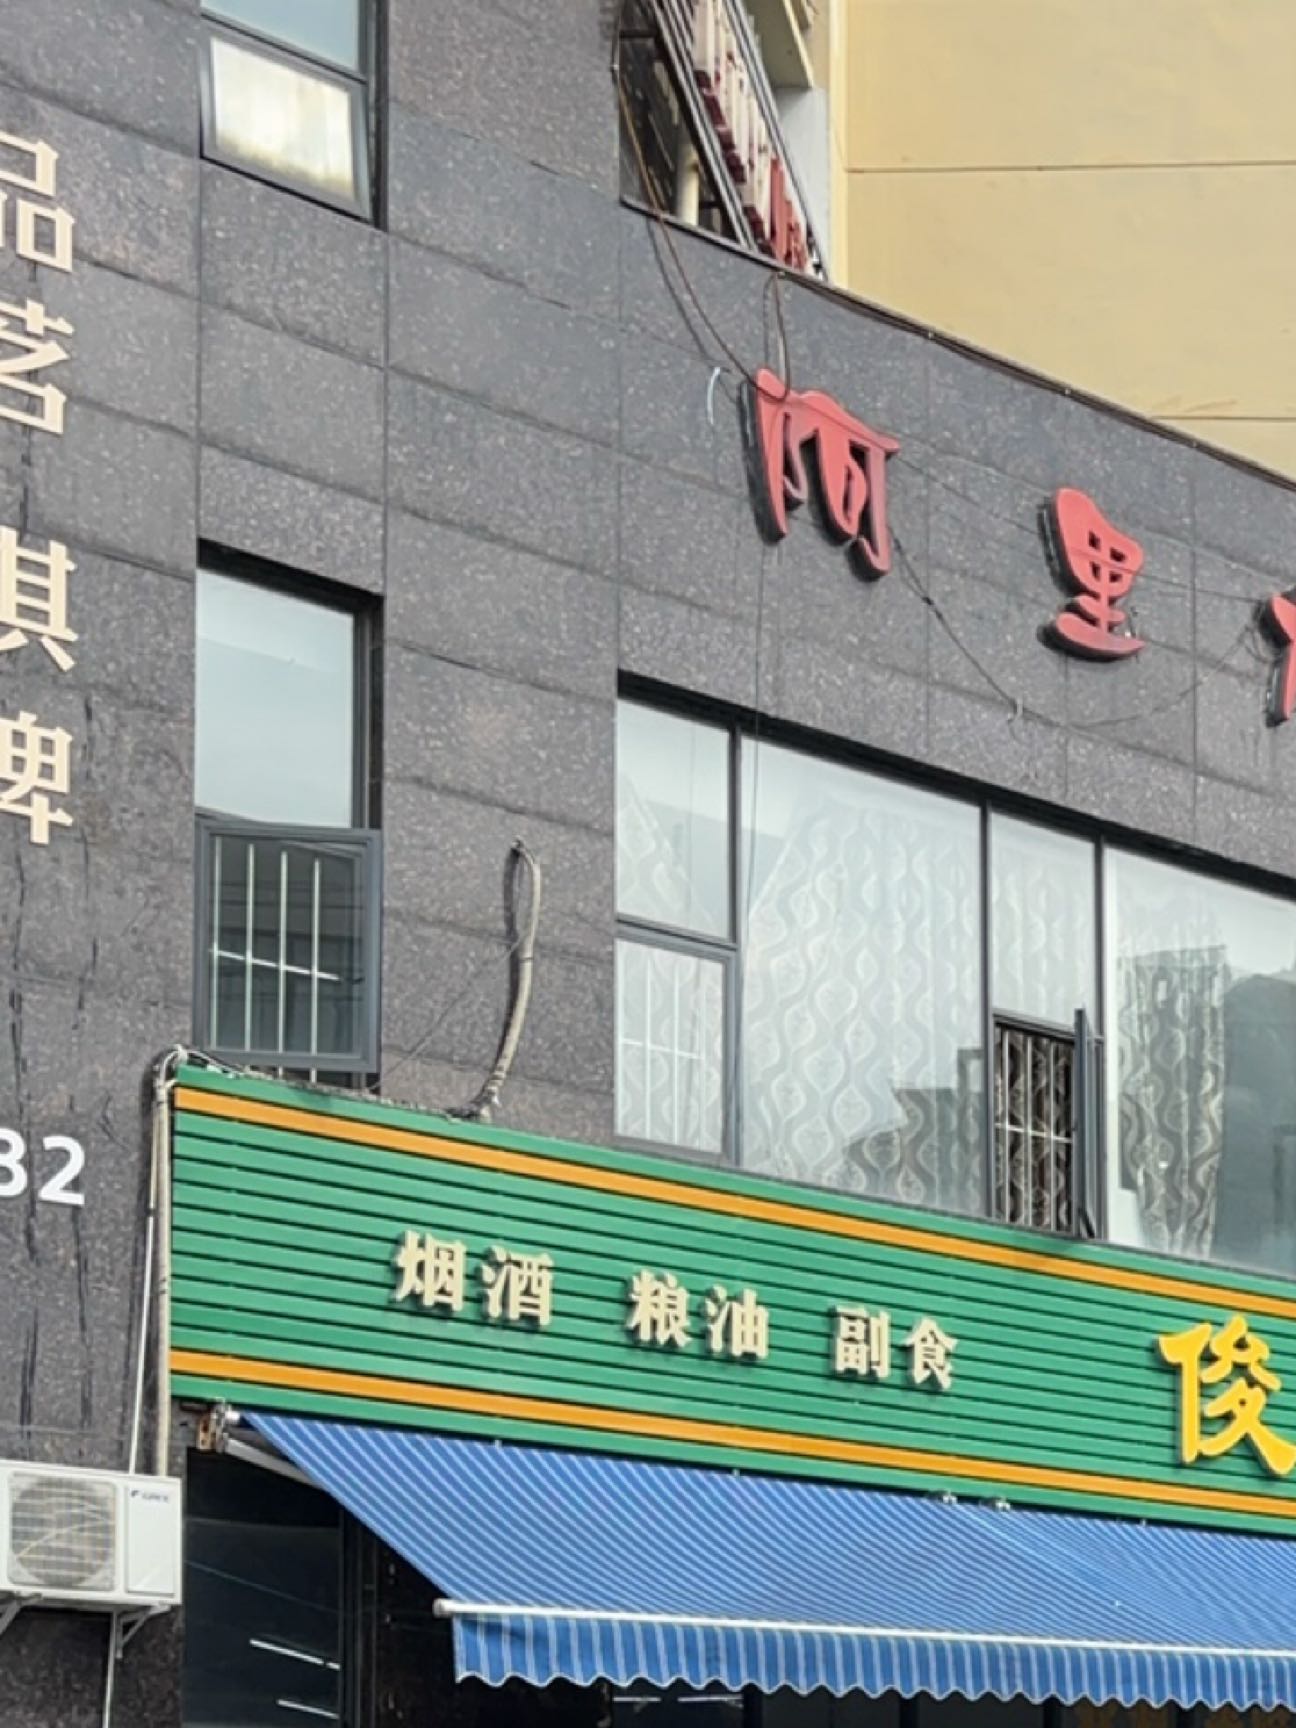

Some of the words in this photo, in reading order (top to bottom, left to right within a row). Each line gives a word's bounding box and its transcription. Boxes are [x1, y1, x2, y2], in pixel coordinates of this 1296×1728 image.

[393, 1230, 556, 1327] 烟酒
[627, 1270, 770, 1360] 粮油
[831, 1304, 959, 1391] 副食
